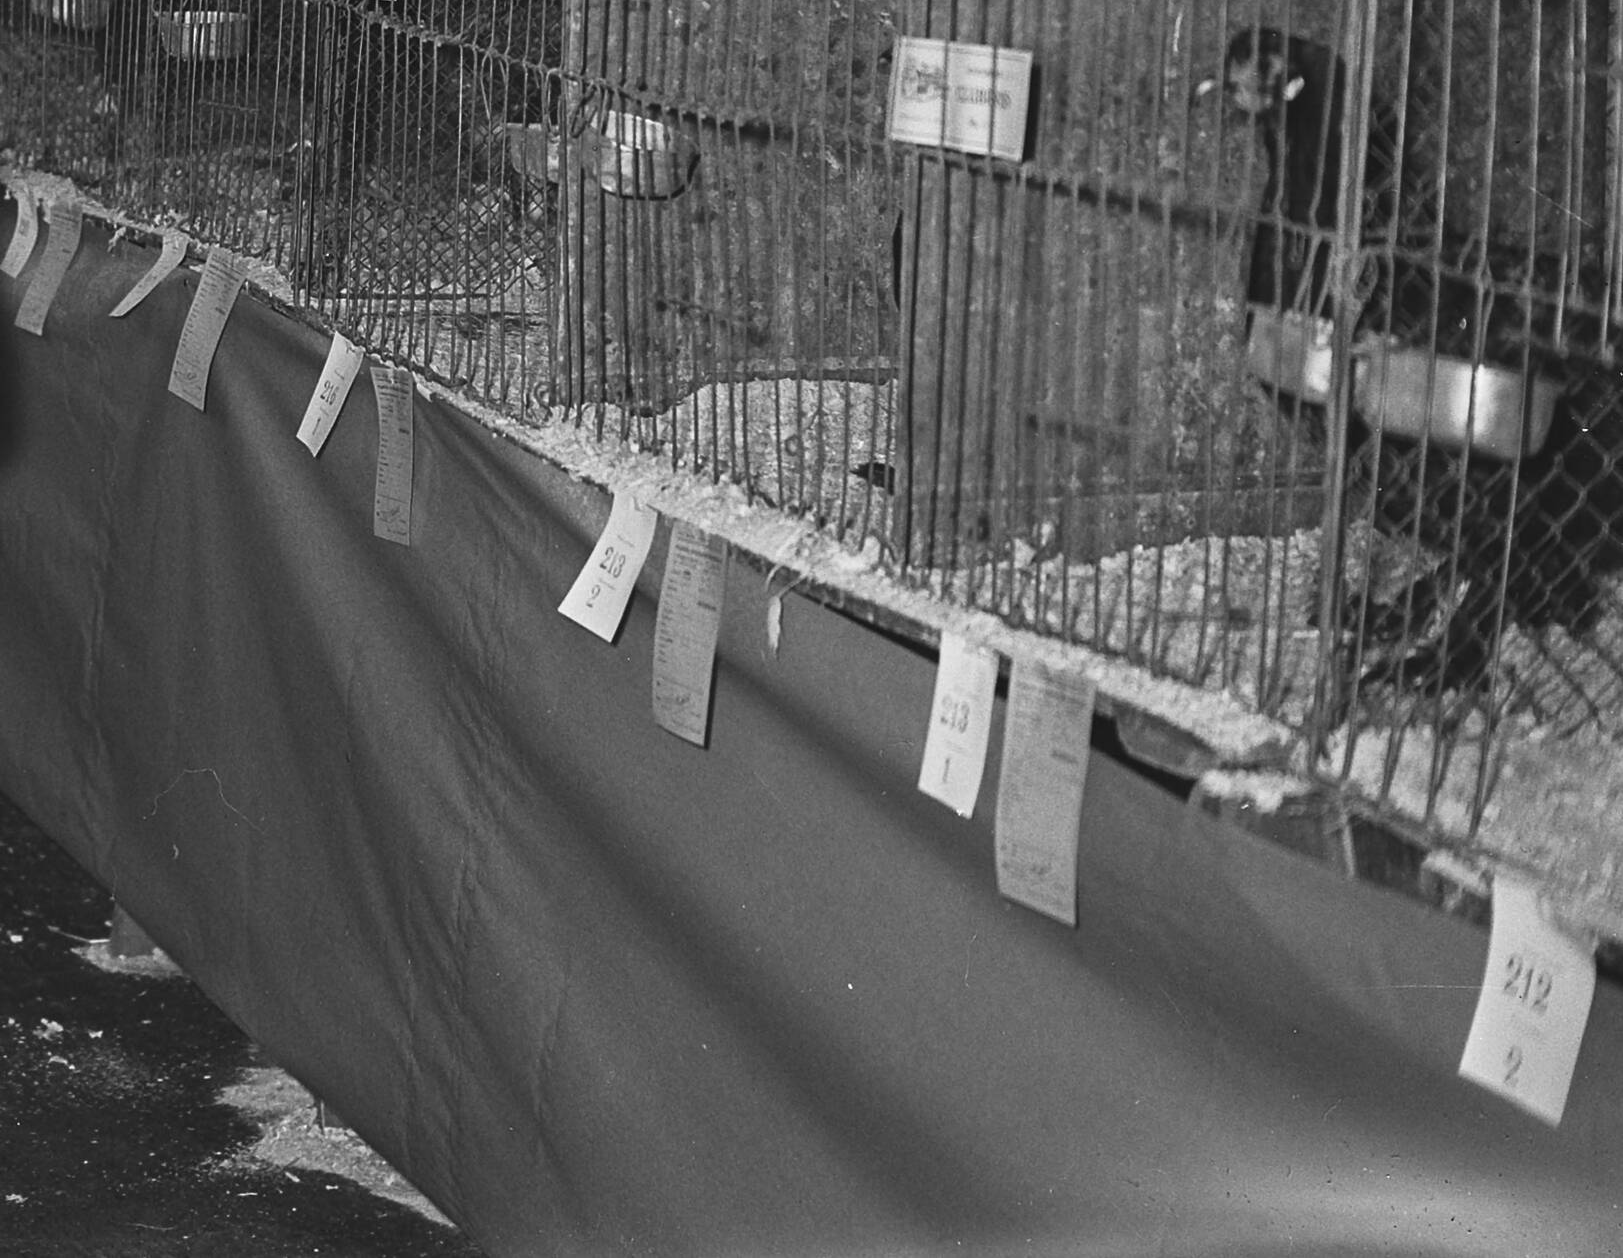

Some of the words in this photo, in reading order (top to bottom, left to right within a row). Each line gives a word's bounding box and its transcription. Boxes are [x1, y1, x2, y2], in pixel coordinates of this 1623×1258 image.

[598, 545, 627, 579] 213
[584, 584, 602, 609] 2
[939, 692, 972, 735] 213
[1503, 951, 1553, 1017] 212
[1502, 1043, 1524, 1088] 2
